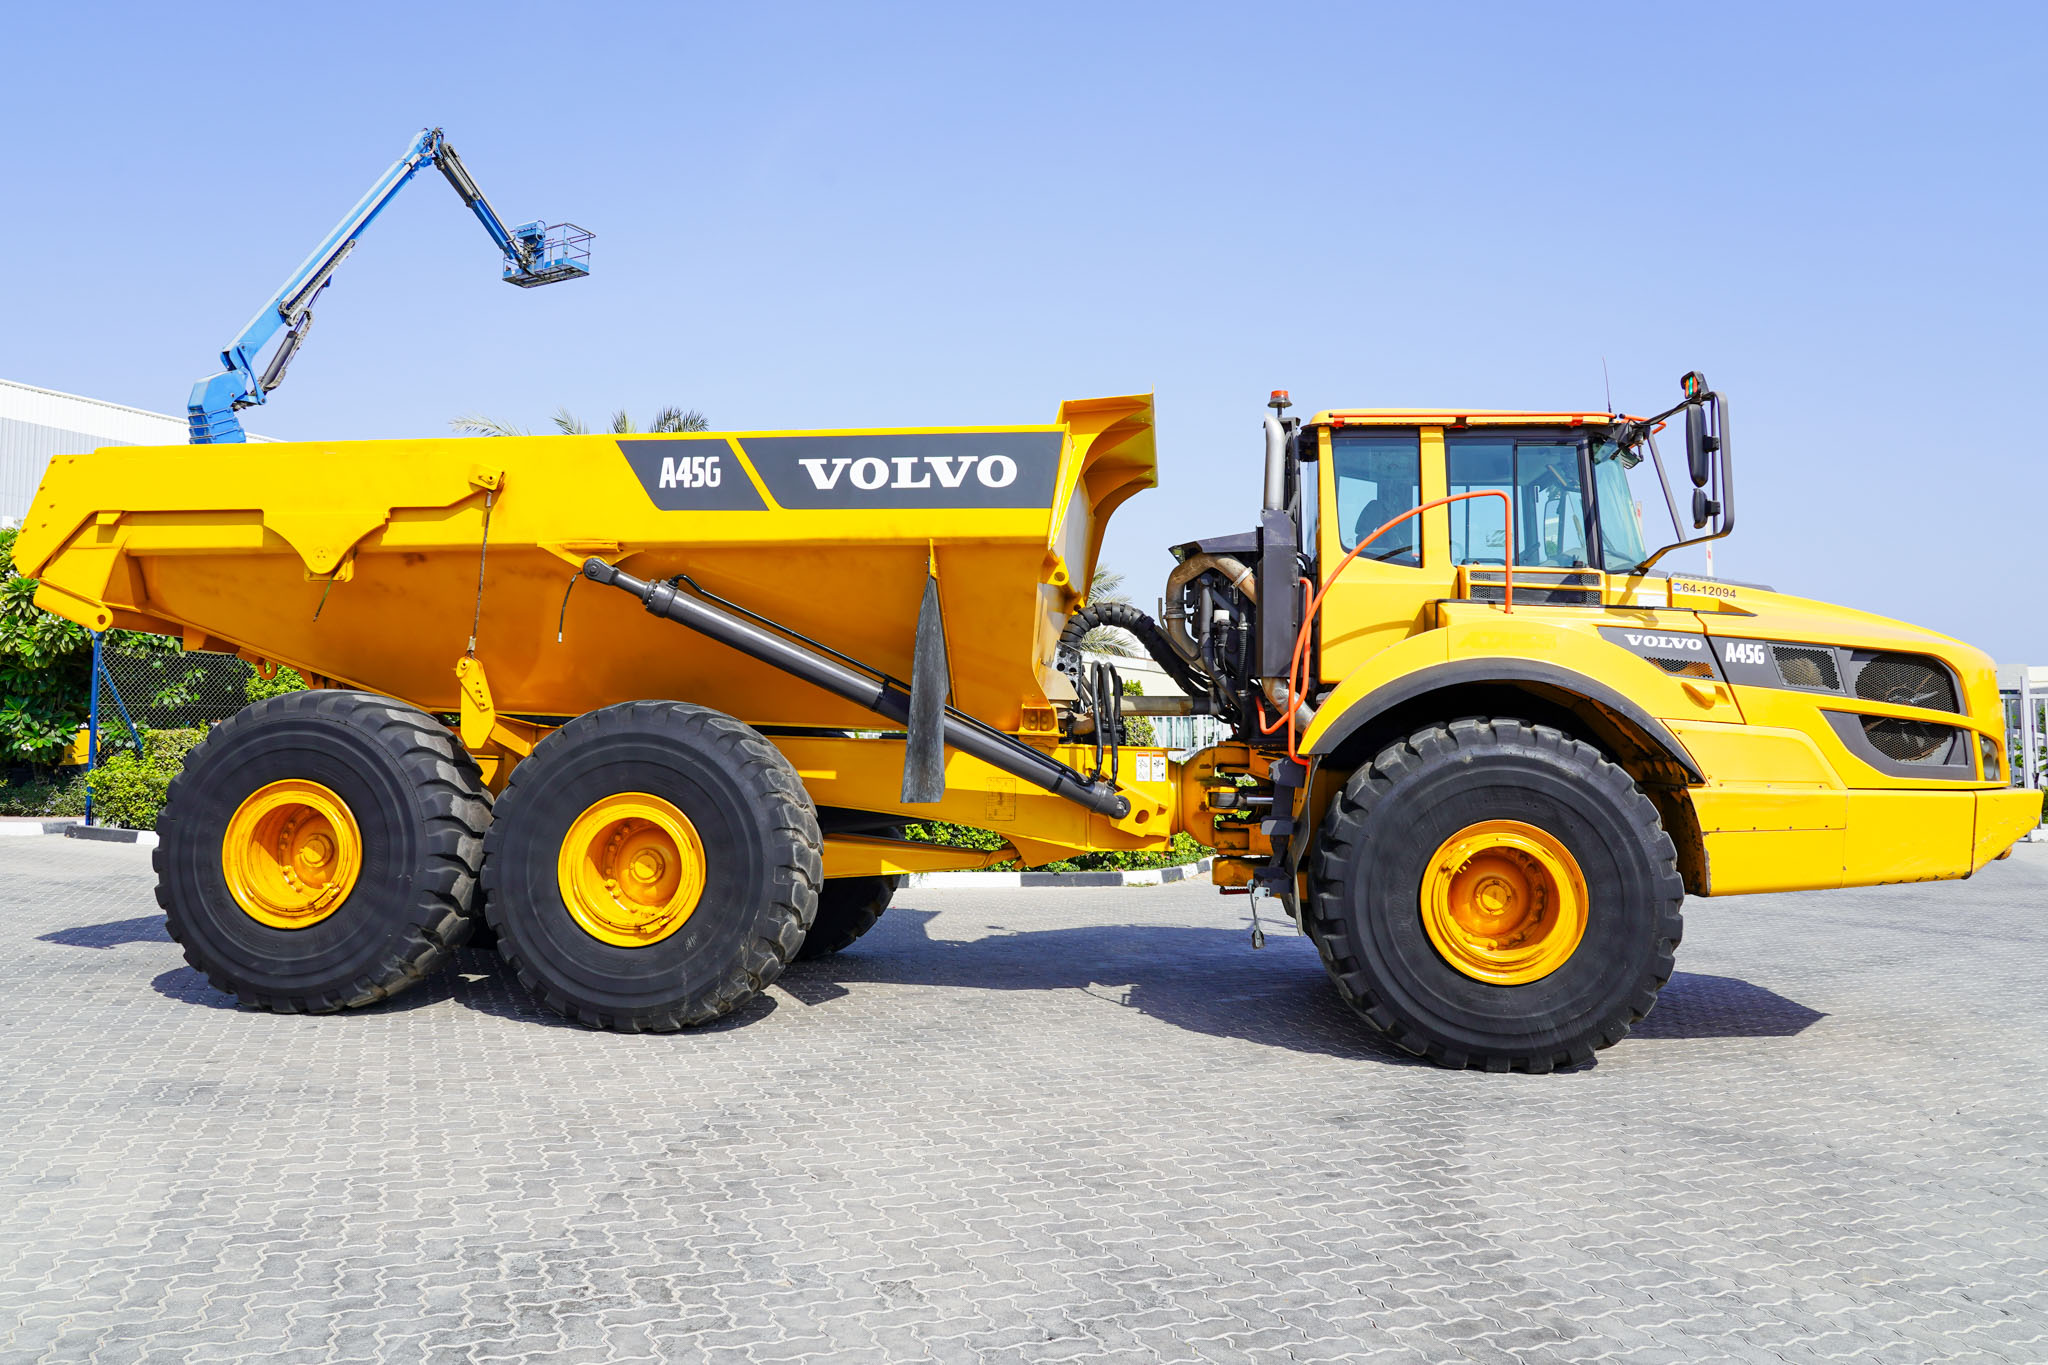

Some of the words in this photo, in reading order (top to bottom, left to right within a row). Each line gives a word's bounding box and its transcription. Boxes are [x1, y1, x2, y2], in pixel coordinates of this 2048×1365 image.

[659, 456, 721, 489] A45G
[798, 455, 1018, 490] VOLVO
[1682, 583, 1737, 598] 64-12094
[1624, 634, 1703, 650] VOLVO
[1725, 642, 1765, 664] A45G
